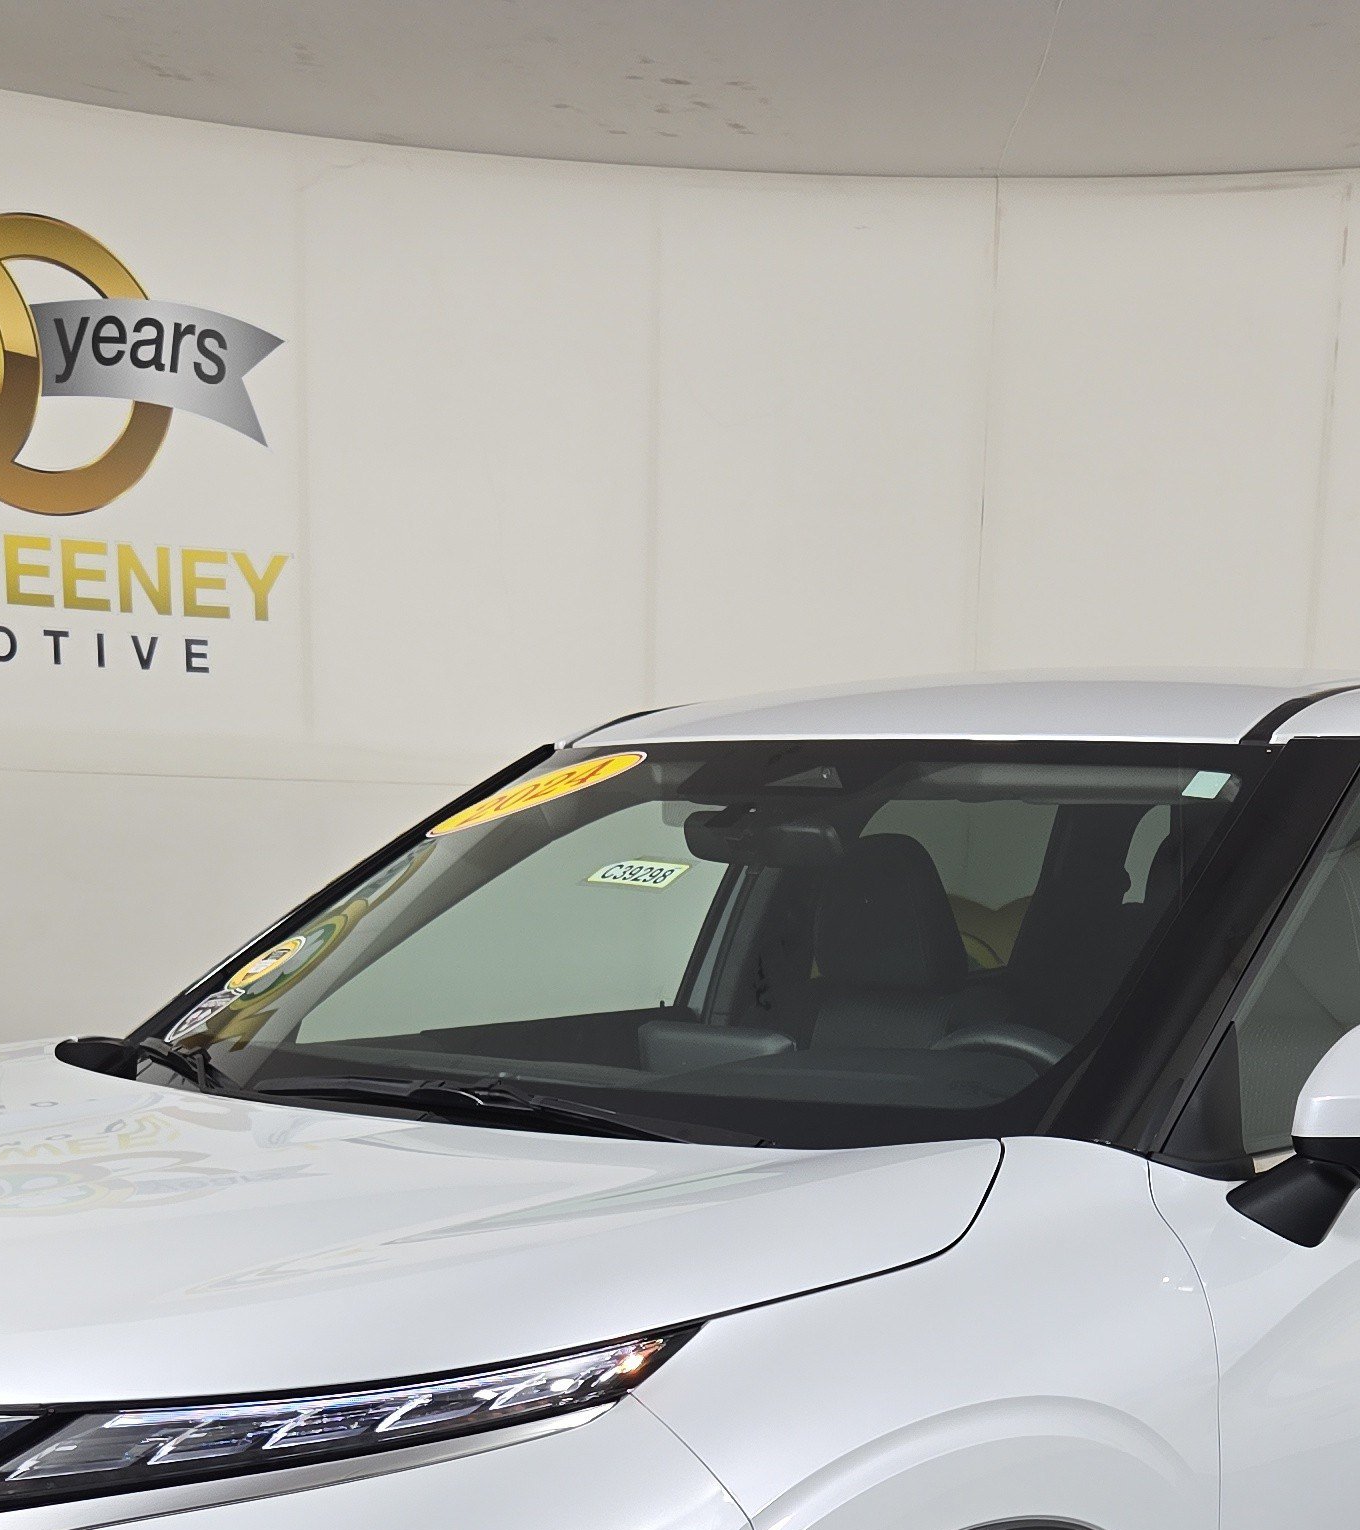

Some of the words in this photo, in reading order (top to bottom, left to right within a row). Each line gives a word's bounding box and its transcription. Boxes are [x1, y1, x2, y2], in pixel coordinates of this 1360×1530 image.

[53, 308, 229, 385] years
[455, 758, 616, 828] 2024
[601, 864, 675, 884] C39298
